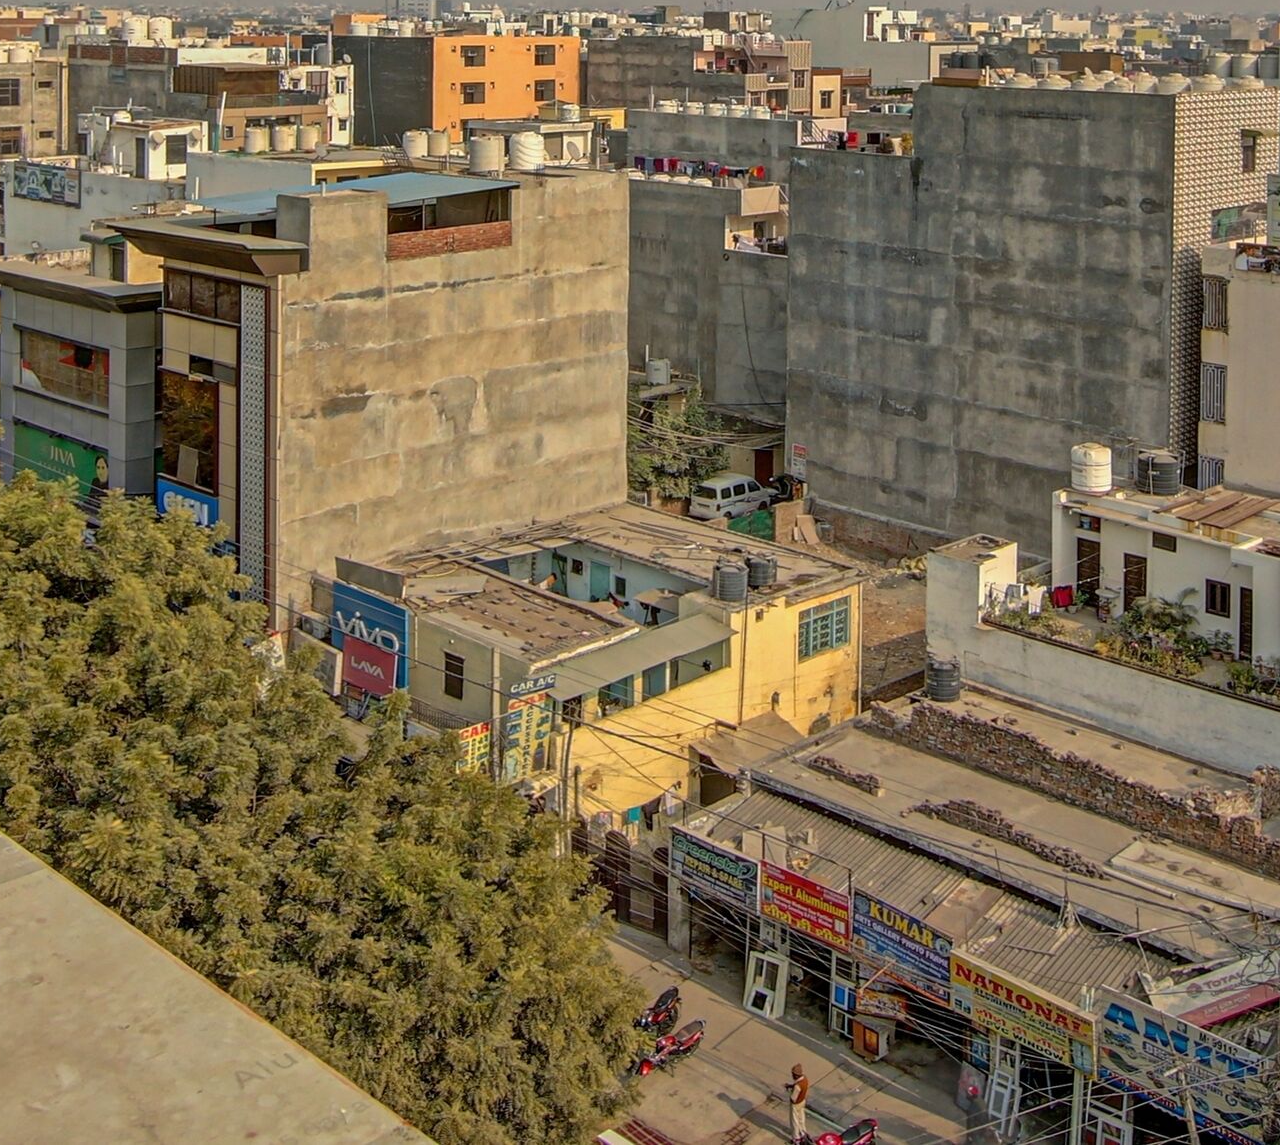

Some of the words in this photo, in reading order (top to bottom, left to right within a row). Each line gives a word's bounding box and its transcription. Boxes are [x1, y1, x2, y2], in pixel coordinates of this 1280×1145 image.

[50, 445, 76, 468] JIVA
[351, 656, 384, 680] LAVA
[510, 682, 534, 693] CAR
[536, 674, 556, 687] A/C
[460, 722, 490, 742] CAR
[761, 874, 794, 897] Expert
[795, 888, 848, 920] Aluminium
[868, 900, 936, 949] KUMAR
[977, 1015, 1009, 1035] UPVC
[1012, 1032, 1064, 1062] WINDOW
